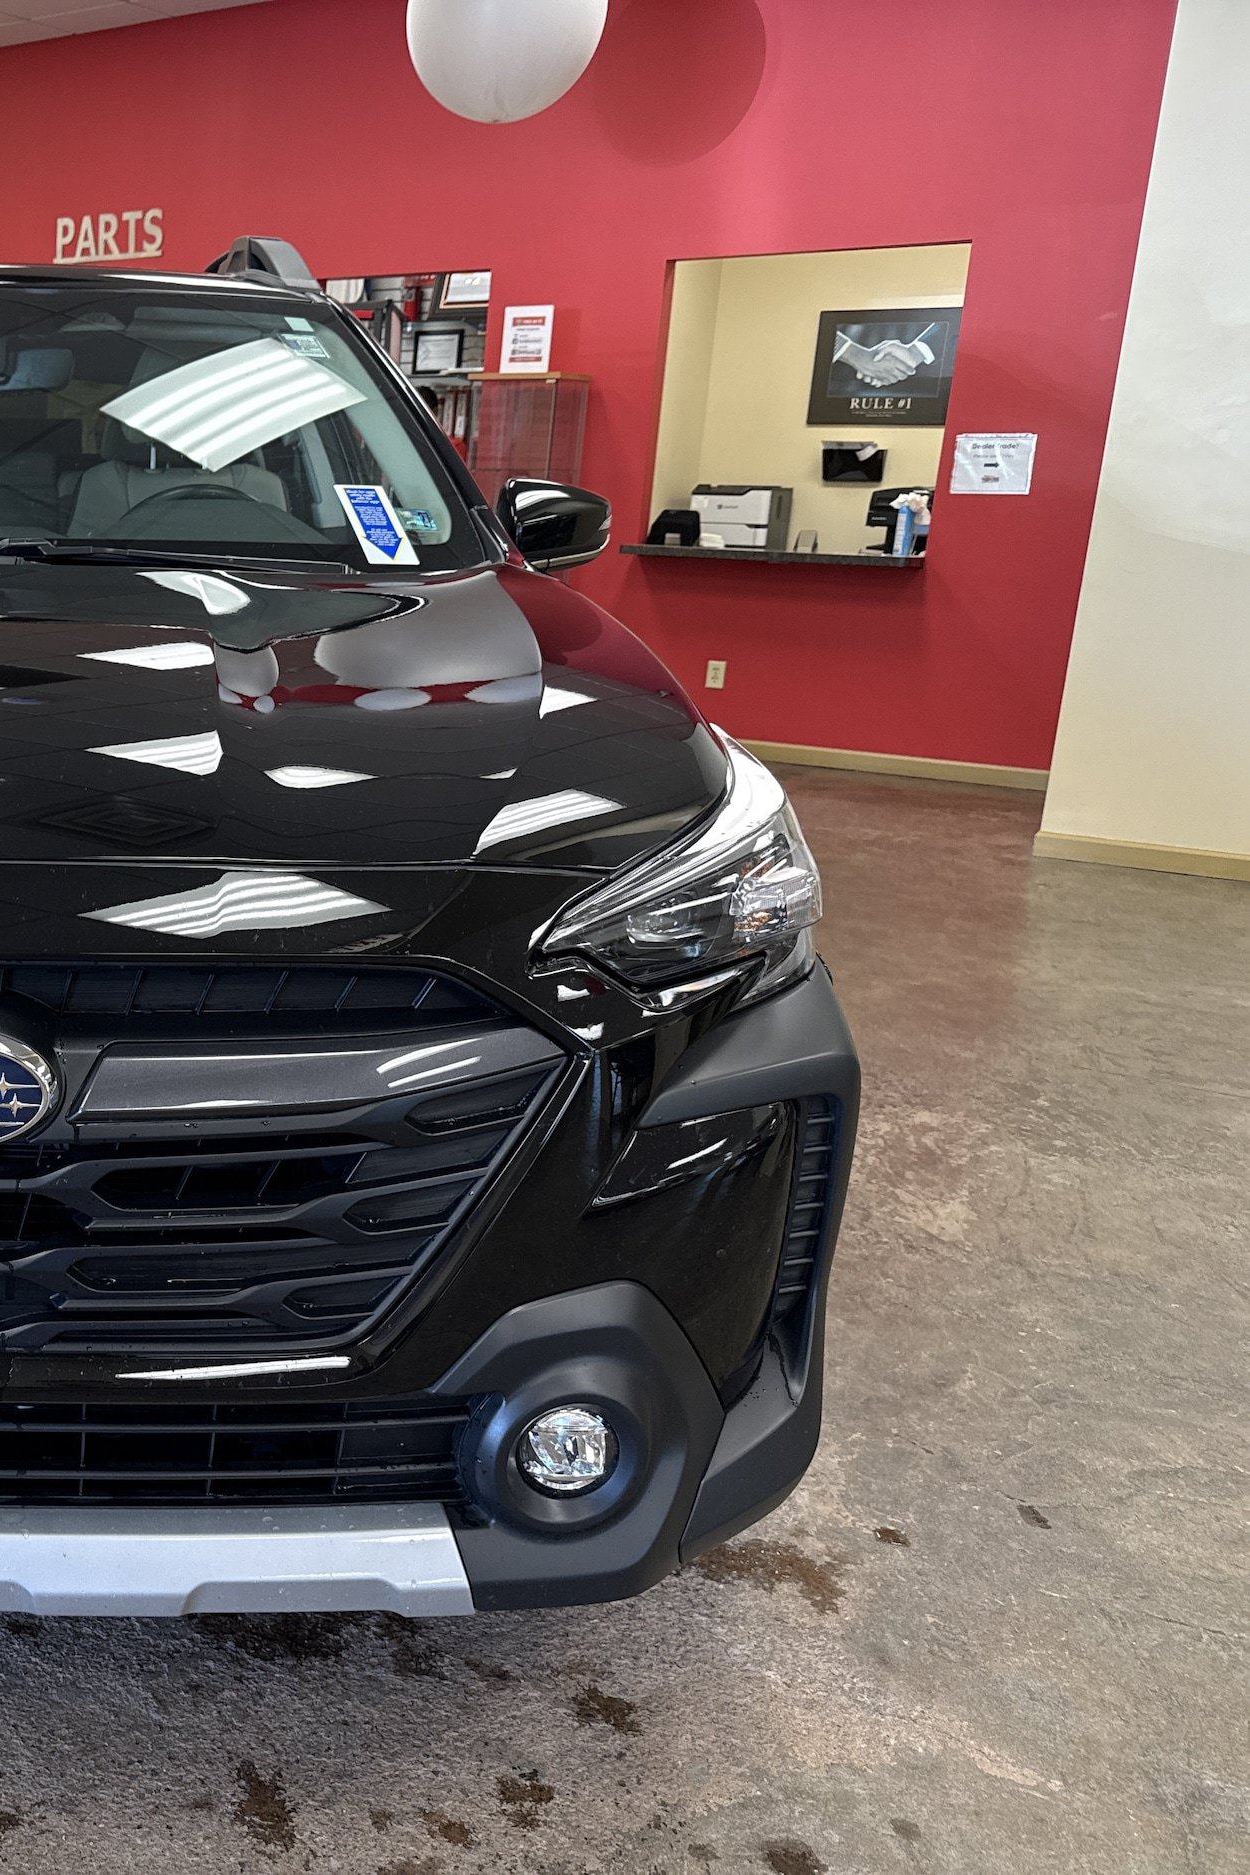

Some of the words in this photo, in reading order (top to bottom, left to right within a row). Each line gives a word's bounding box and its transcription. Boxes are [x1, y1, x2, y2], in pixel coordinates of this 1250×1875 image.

[53, 208, 164, 262] PARTS
[850, 397, 894, 409] RULE
[897, 397, 912, 409] #1
